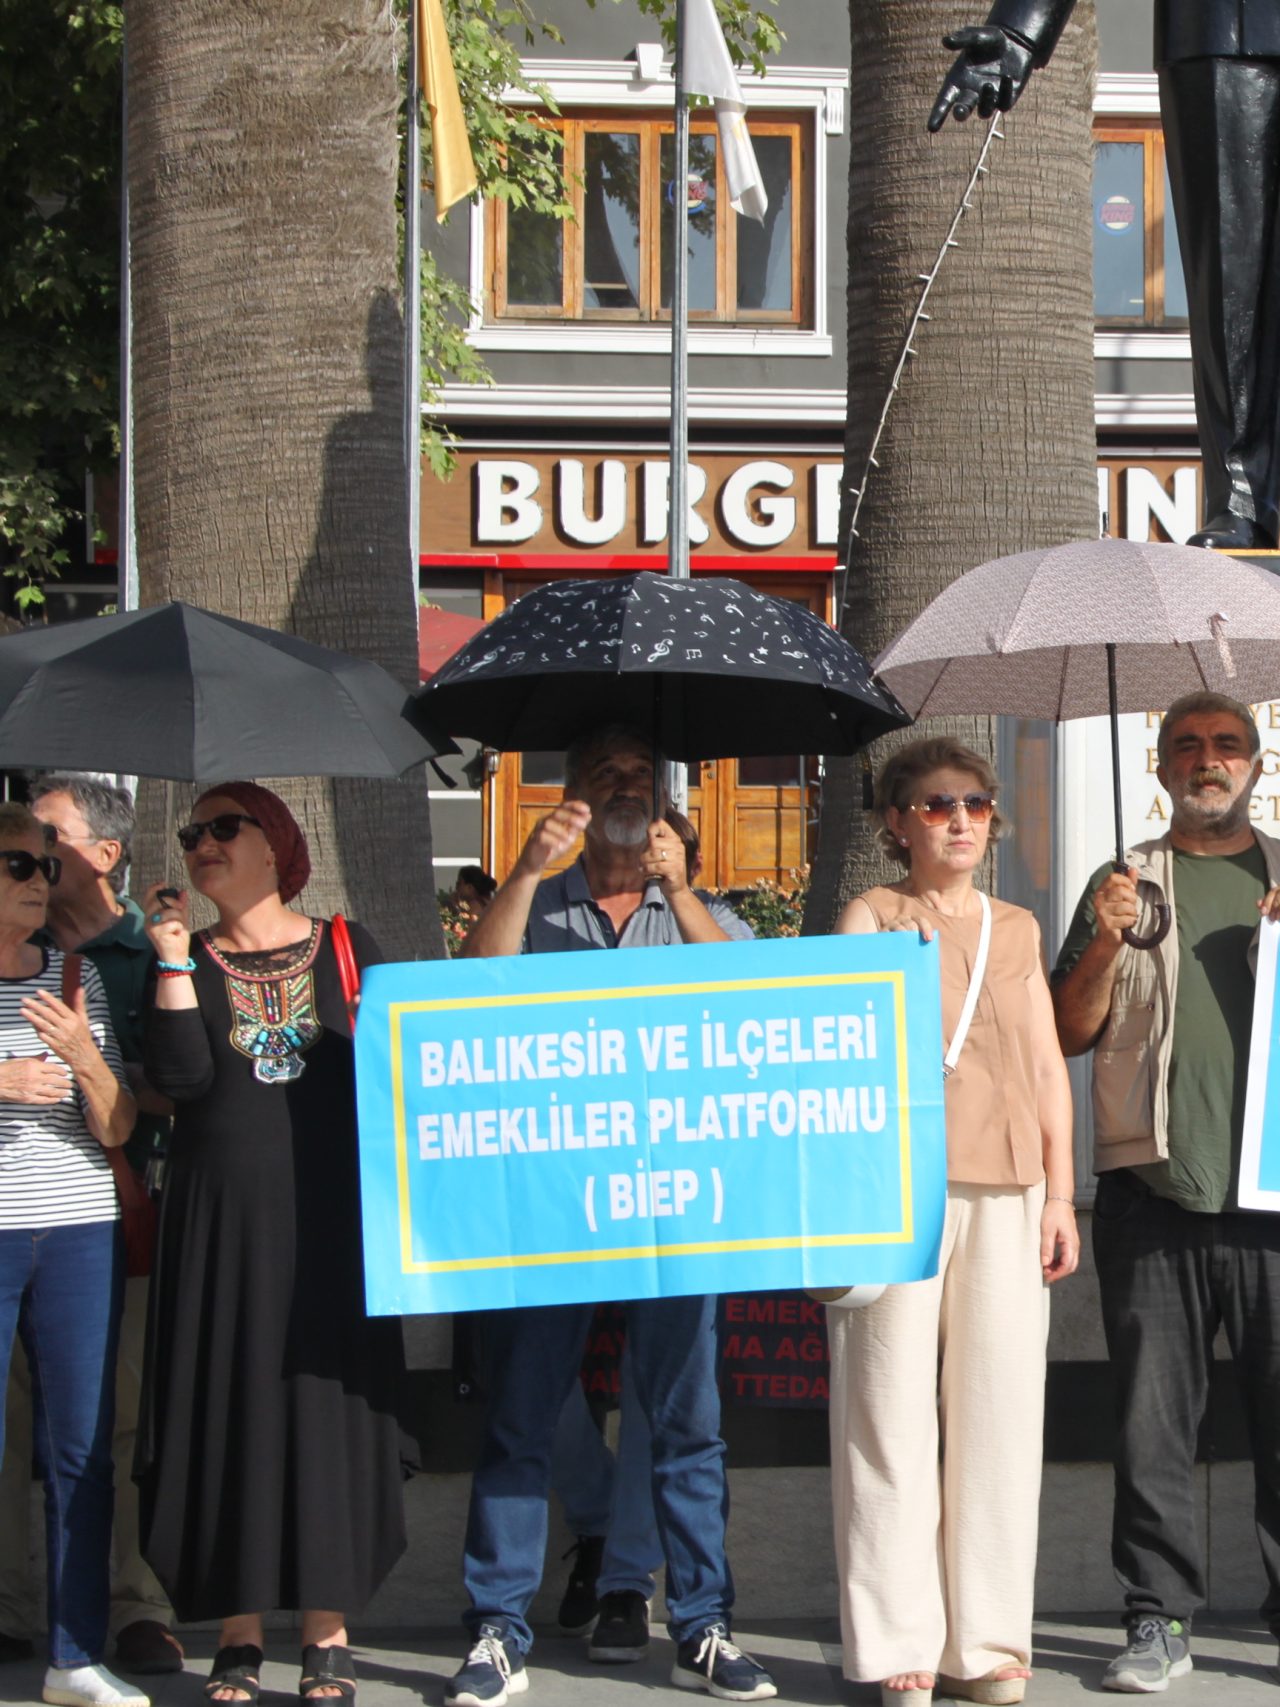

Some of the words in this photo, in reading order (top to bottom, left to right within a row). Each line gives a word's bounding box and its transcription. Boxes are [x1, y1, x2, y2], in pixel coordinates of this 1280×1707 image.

[420, 1018, 626, 1087] BALIKESİR
[638, 1025, 689, 1072] VE
[702, 1001, 878, 1079] İLÇELERİ
[417, 1093, 636, 1160] EMEKLİLER
[650, 1086, 886, 1144] PLATFORMU
[609, 1159, 698, 1220] BİEP
[725, 1299, 822, 1325] EMEK
[731, 1372, 829, 1400] TTEDA
